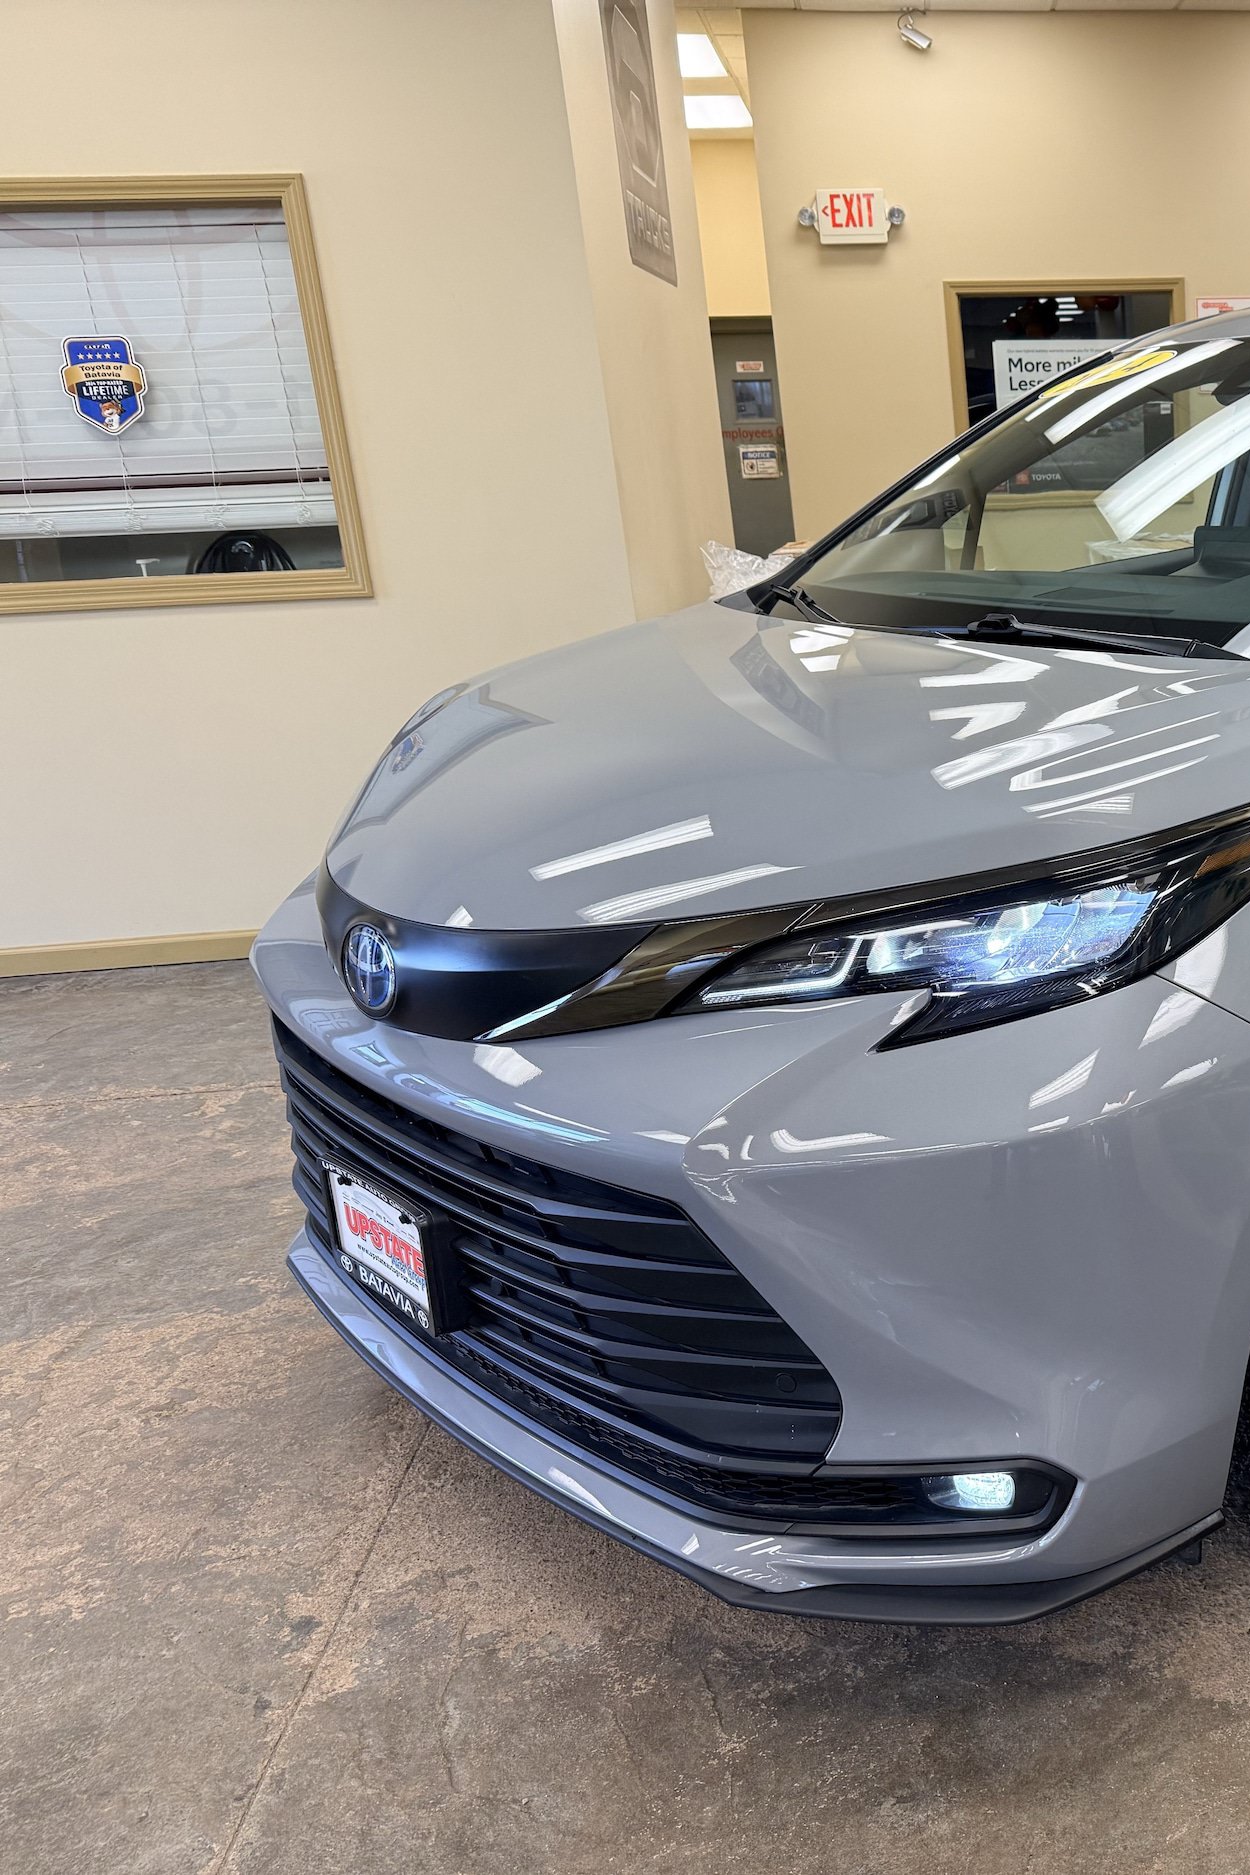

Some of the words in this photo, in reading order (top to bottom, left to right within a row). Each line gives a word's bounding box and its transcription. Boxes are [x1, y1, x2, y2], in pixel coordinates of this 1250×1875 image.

[829, 193, 875, 228] EXIT
[79, 364, 112, 372] Toyota
[84, 371, 122, 379] Batavia
[1008, 358, 1052, 373] More
[82, 385, 130, 396] LIFETIME
[321, 1160, 365, 1188] UPSTATE
[365, 1183, 388, 1202] AUTO
[343, 1201, 425, 1279] UPSTATE
[359, 1264, 415, 1319] BATAVIA
